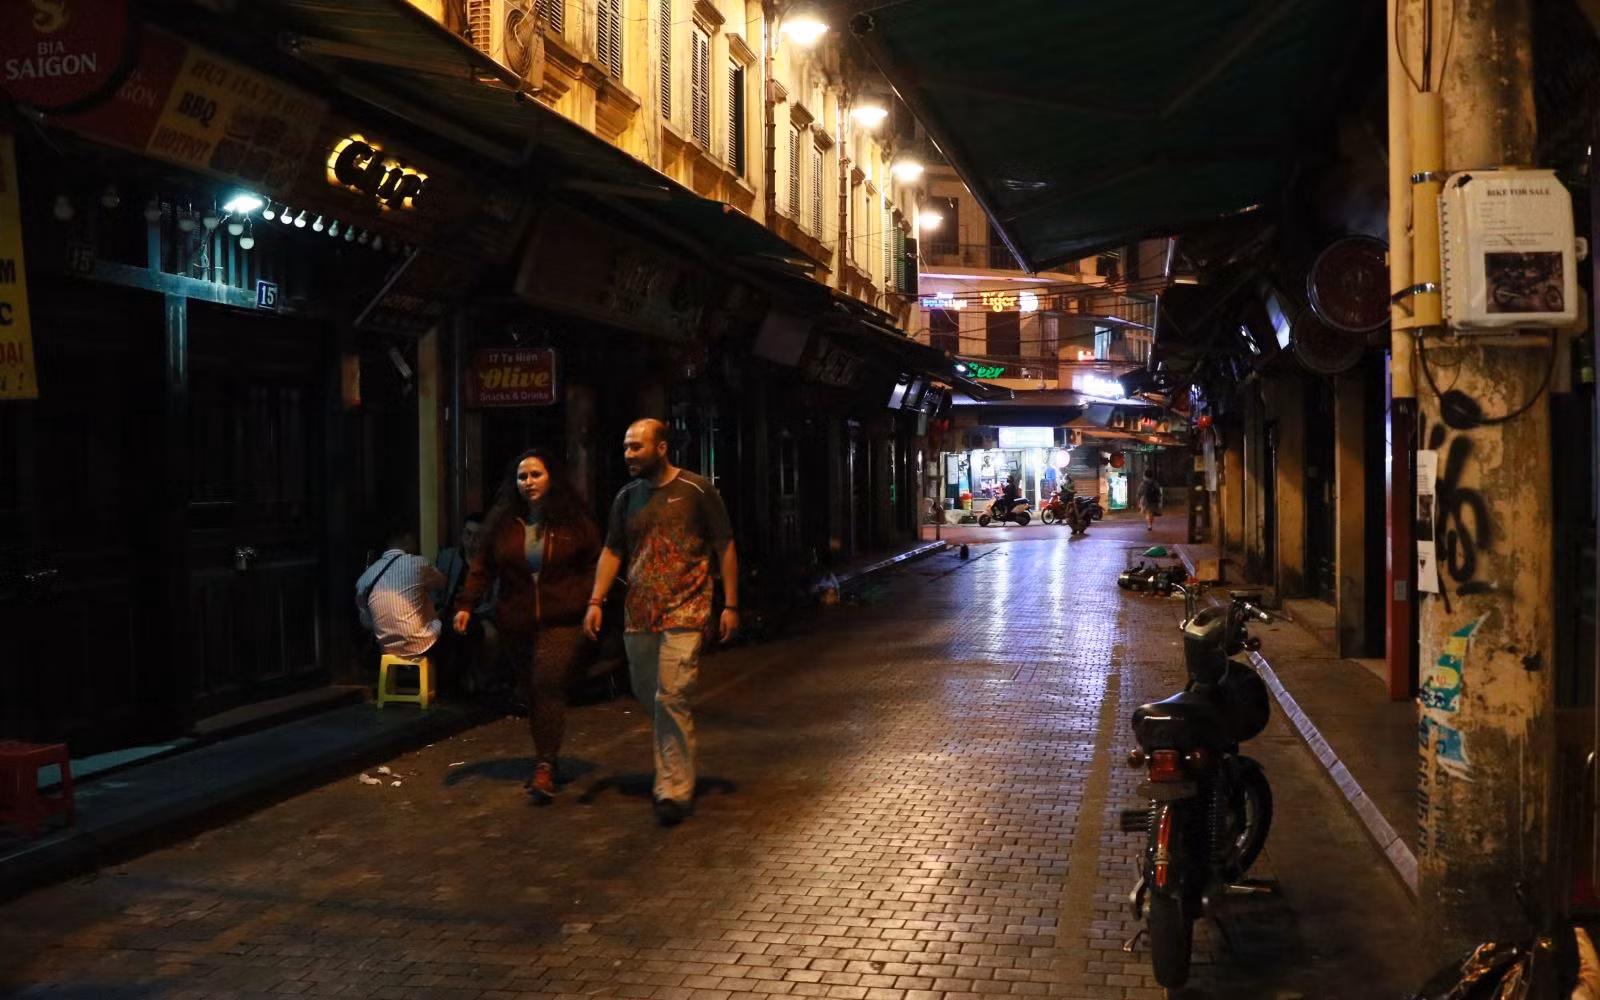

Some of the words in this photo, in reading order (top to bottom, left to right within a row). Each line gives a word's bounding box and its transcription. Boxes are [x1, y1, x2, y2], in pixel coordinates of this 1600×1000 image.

[37, 40, 65, 55] BIA
[4, 52, 97, 80] SAIGON
[178, 91, 217, 128] BBQ
[1487, 188, 1507, 196] BIKE
[1510, 188, 1527, 196] FOR
[1529, 187, 1550, 196] SALE
[260, 284, 276, 306] 15
[980, 291, 1018, 313] Tiger
[489, 353, 499, 364] 17
[479, 366, 549, 389] Olive
[480, 390, 511, 401] Snacks
[520, 390, 550, 401] Drinks
